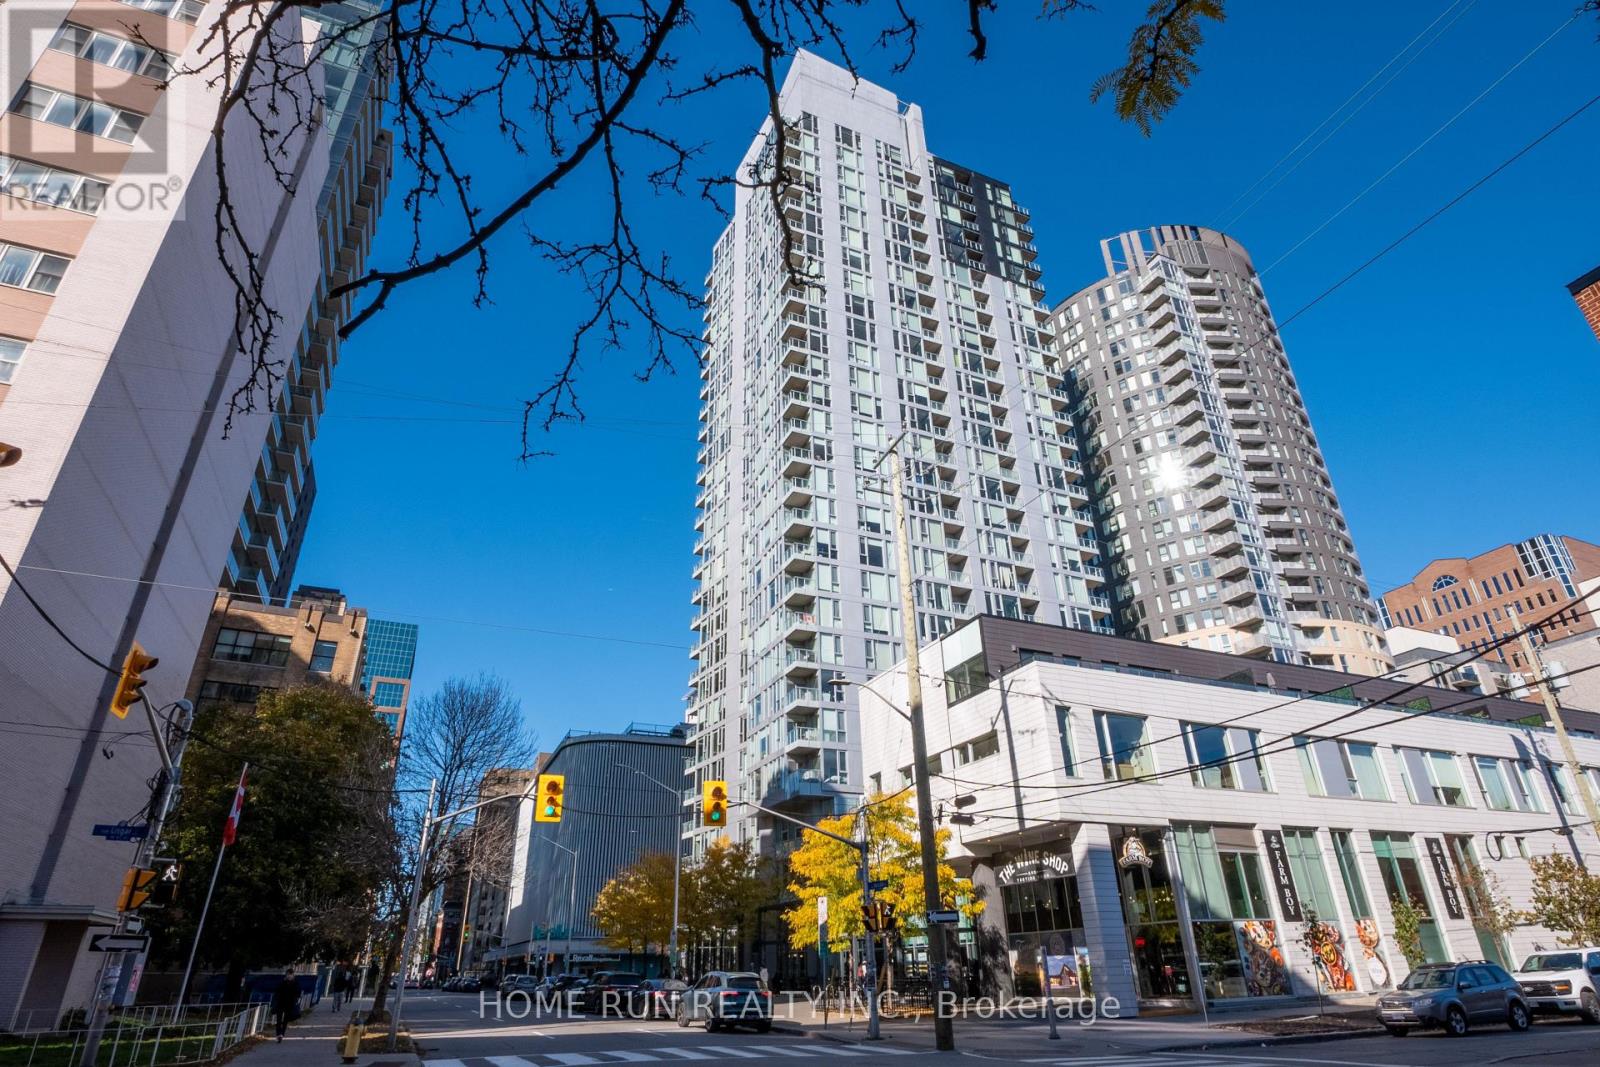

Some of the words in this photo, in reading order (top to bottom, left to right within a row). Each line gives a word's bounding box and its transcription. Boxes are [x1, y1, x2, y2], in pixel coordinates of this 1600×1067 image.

[998, 861, 1016, 885] THE
[1014, 848, 1041, 869] WINE
[1042, 851, 1069, 874] SHOP
[1275, 851, 1289, 885] FARM
[1284, 888, 1295, 915] BOY
